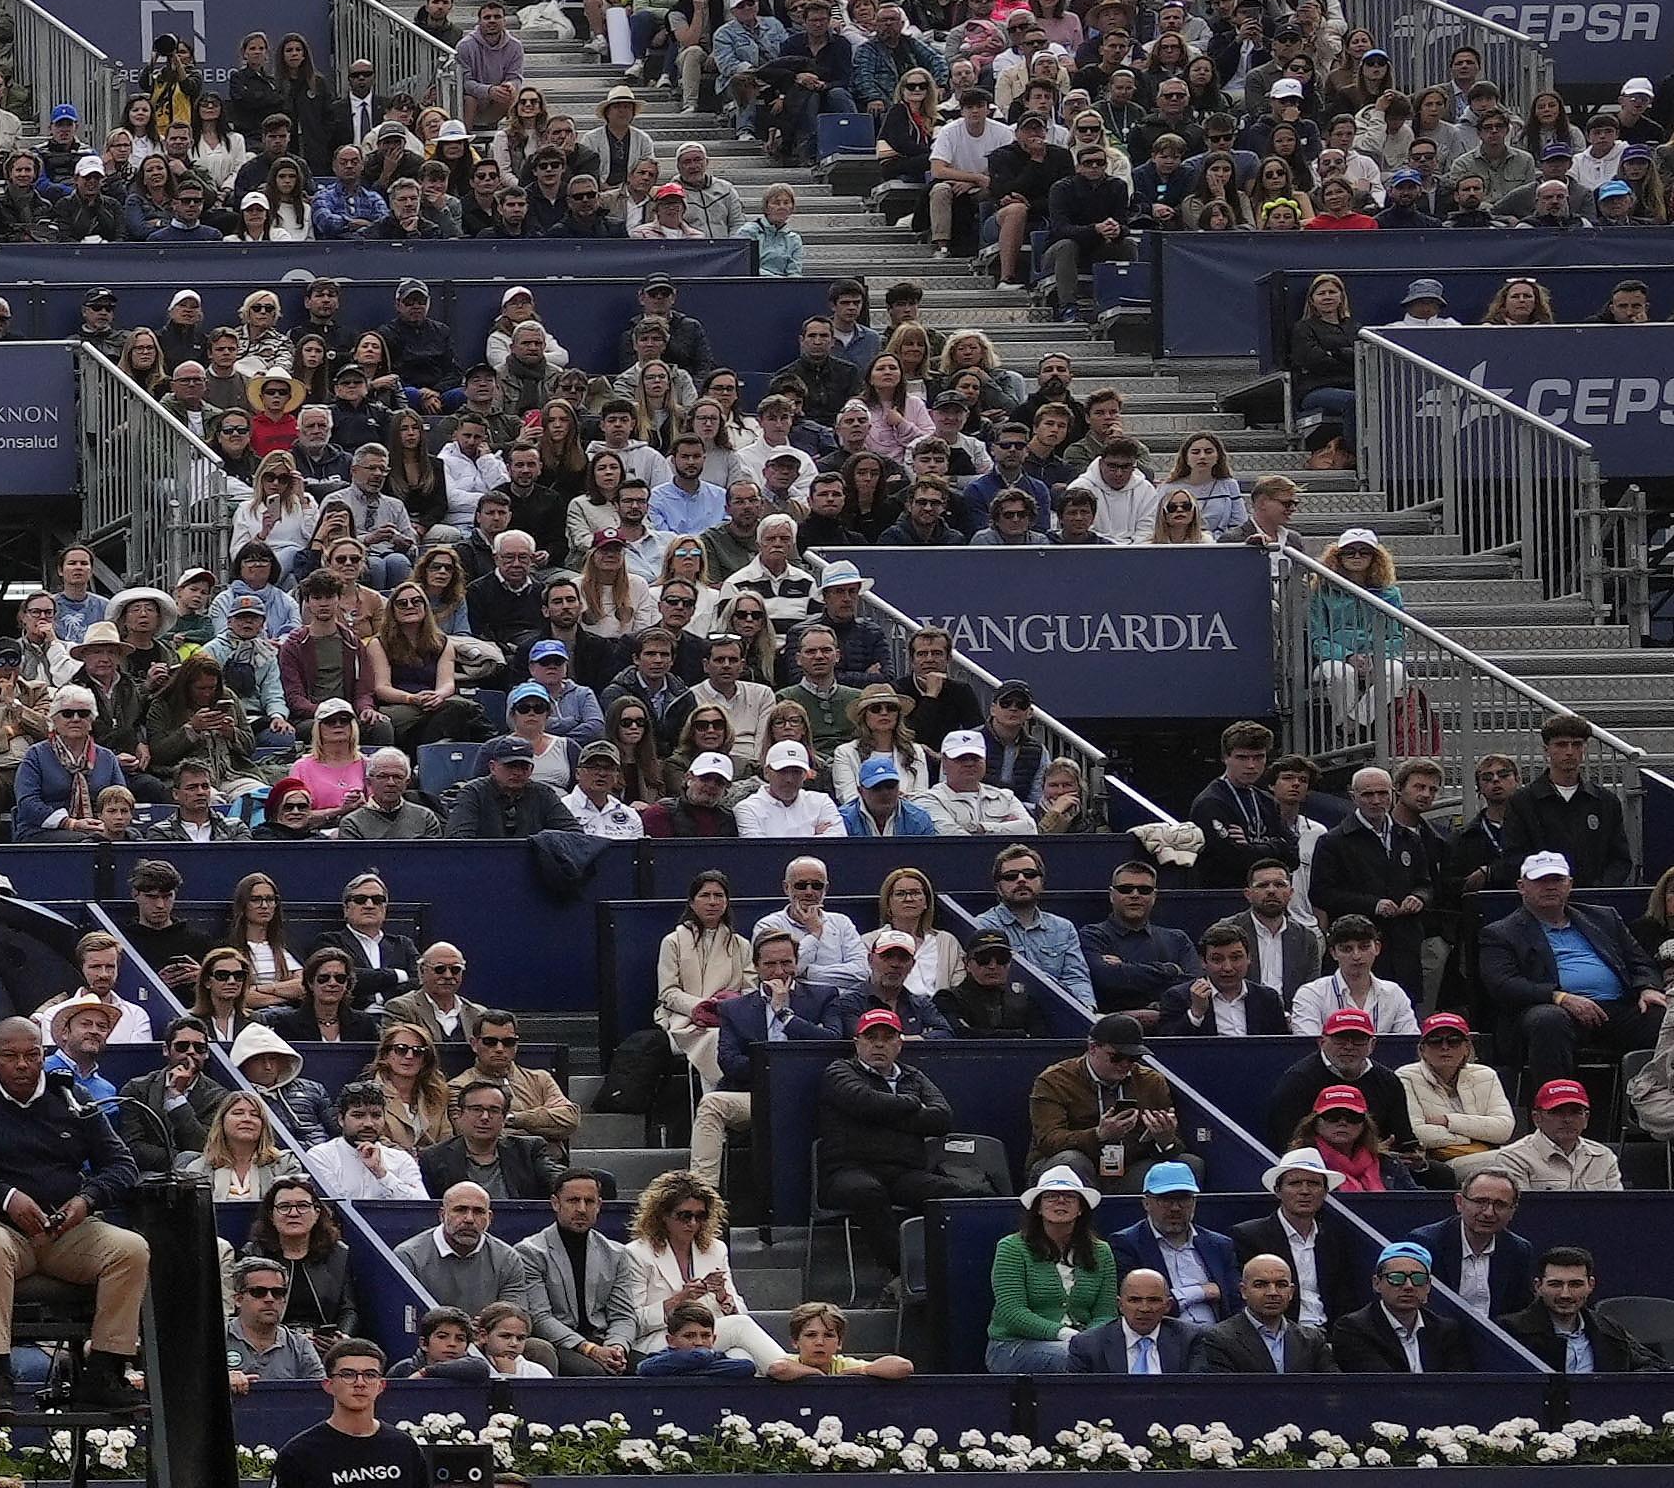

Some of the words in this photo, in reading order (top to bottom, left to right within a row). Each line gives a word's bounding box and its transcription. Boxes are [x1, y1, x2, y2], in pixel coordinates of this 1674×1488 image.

[1482, 3, 1661, 42] CEPSA
[1527, 378, 1674, 425] CEP
[332, 1465, 401, 1486] MANGO
